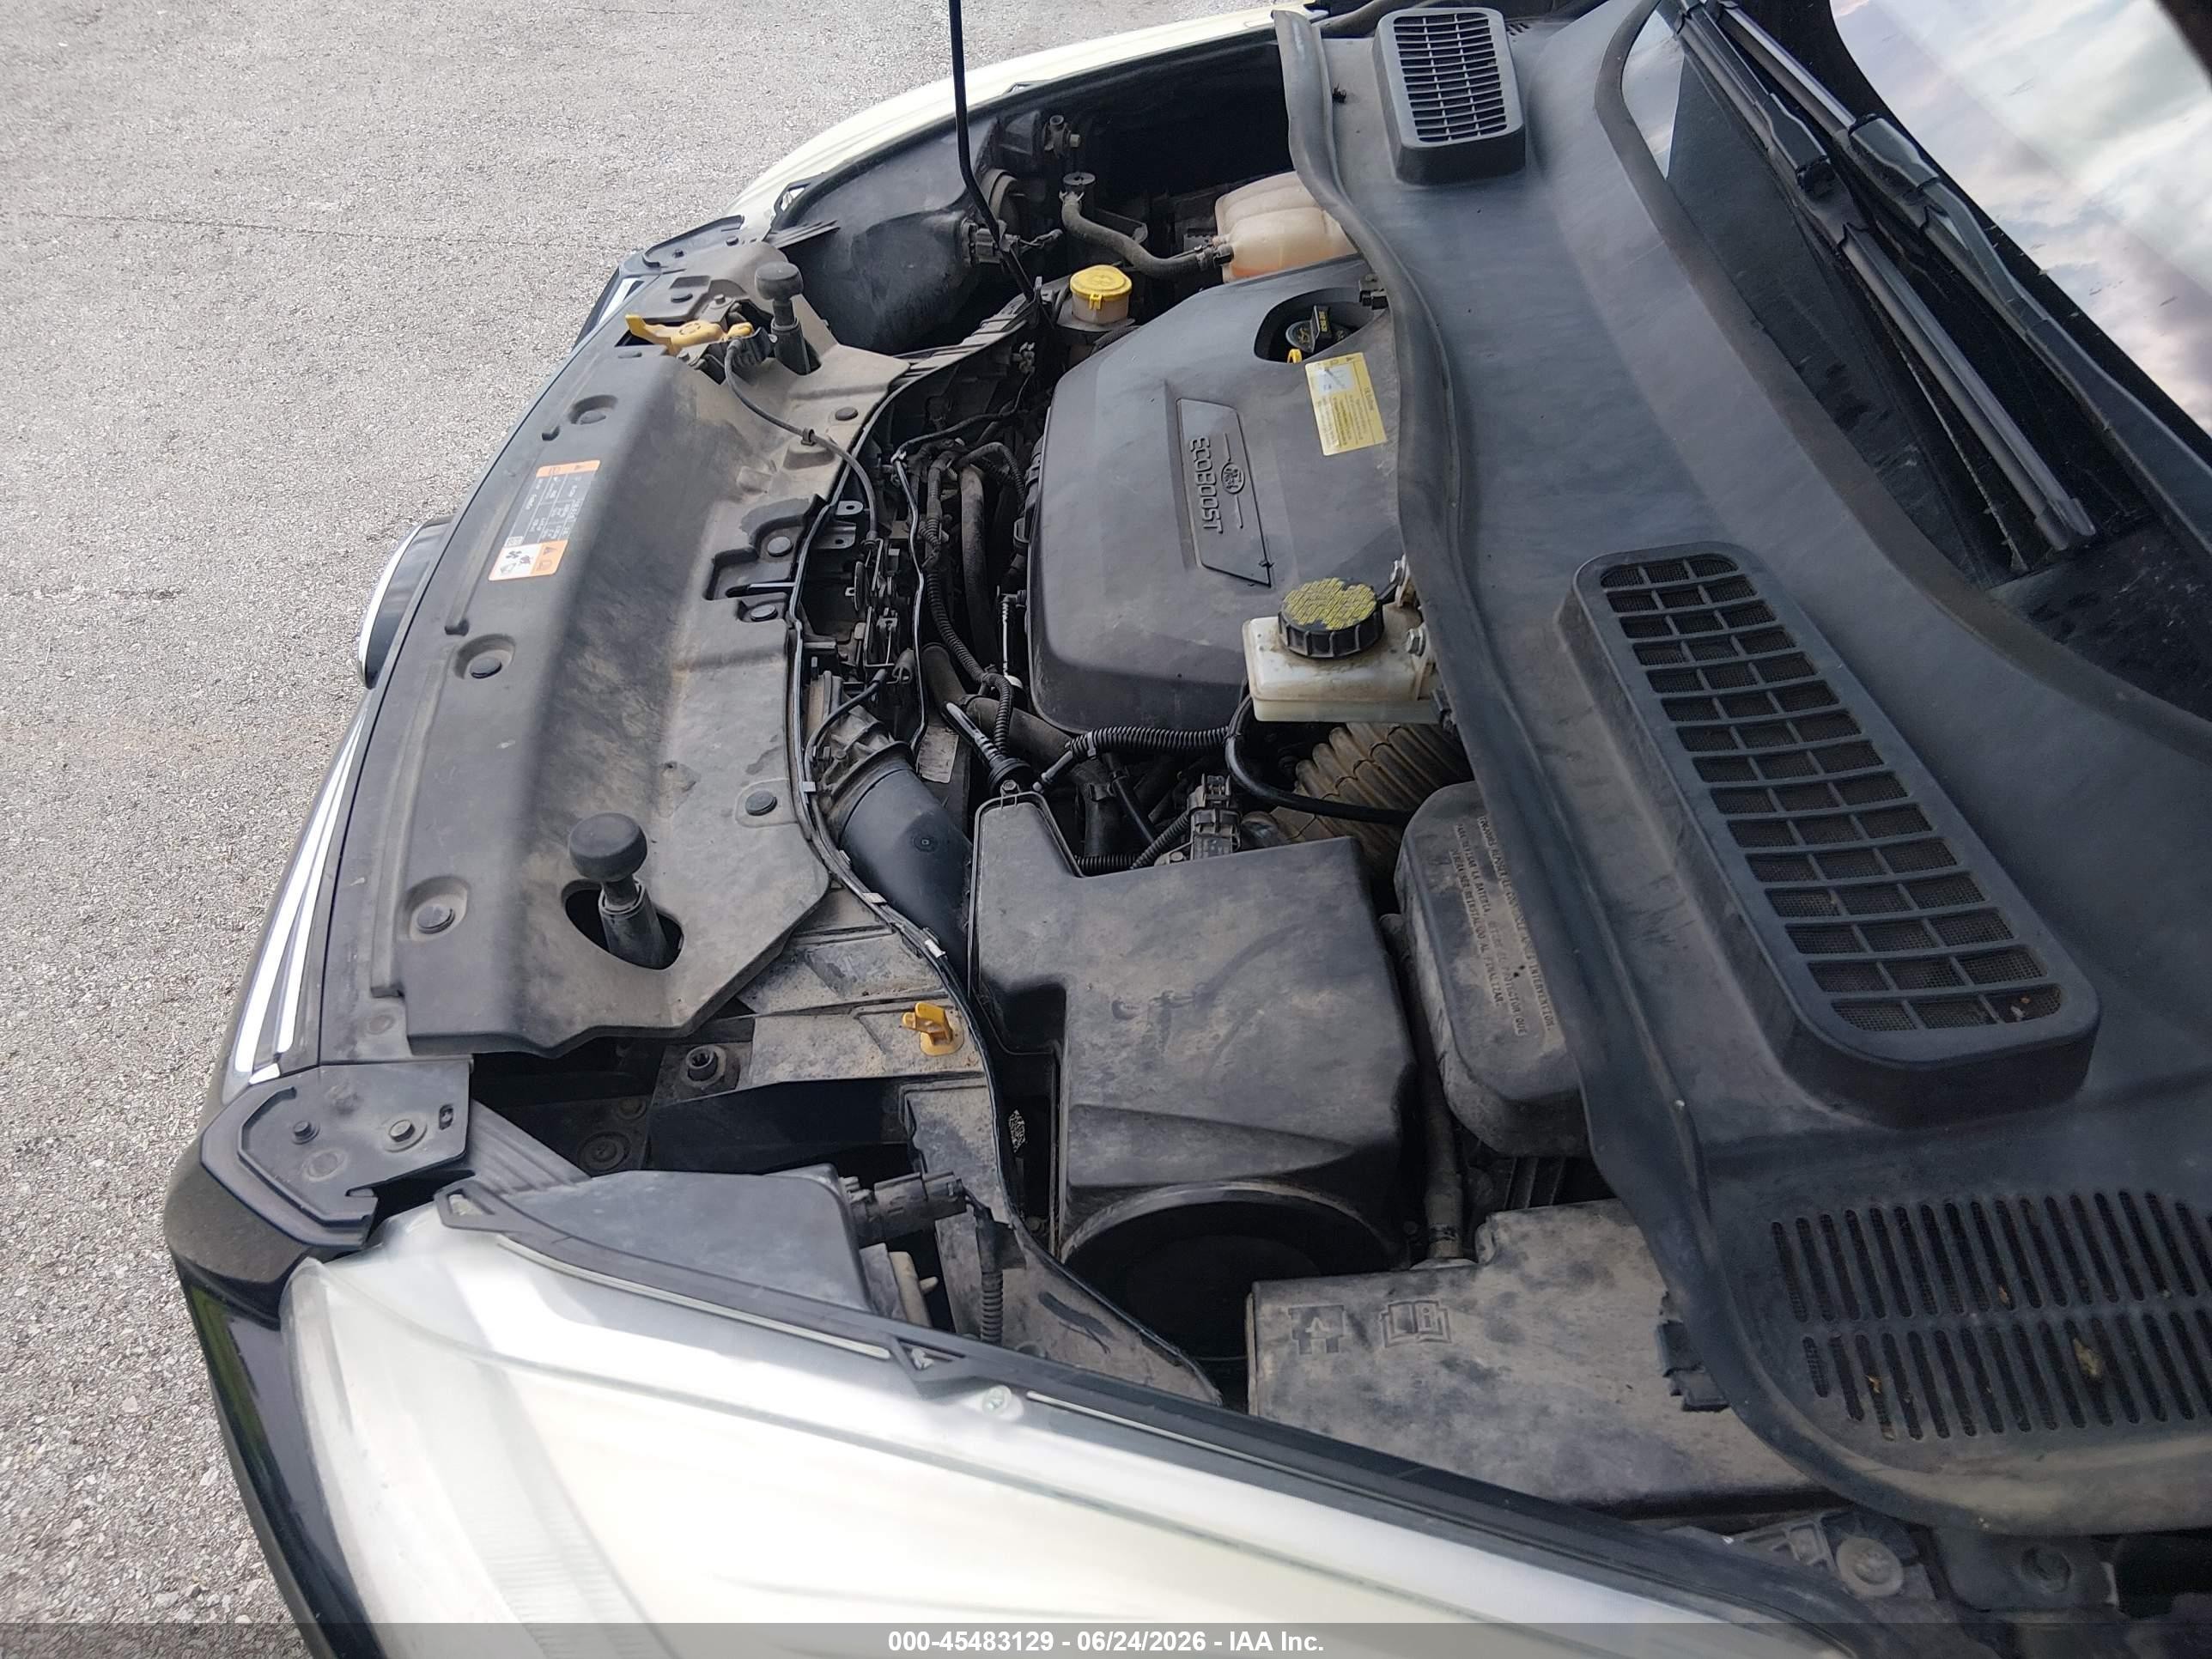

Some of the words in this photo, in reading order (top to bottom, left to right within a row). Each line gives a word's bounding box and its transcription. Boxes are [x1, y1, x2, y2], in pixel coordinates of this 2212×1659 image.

[1190, 437, 1223, 533] ECOBOOST
[1461, 874, 1471, 888] SER
[1480, 942, 1490, 953] AL
[1471, 870, 1480, 880] LA
[1515, 1017, 1527, 1035] QUE
